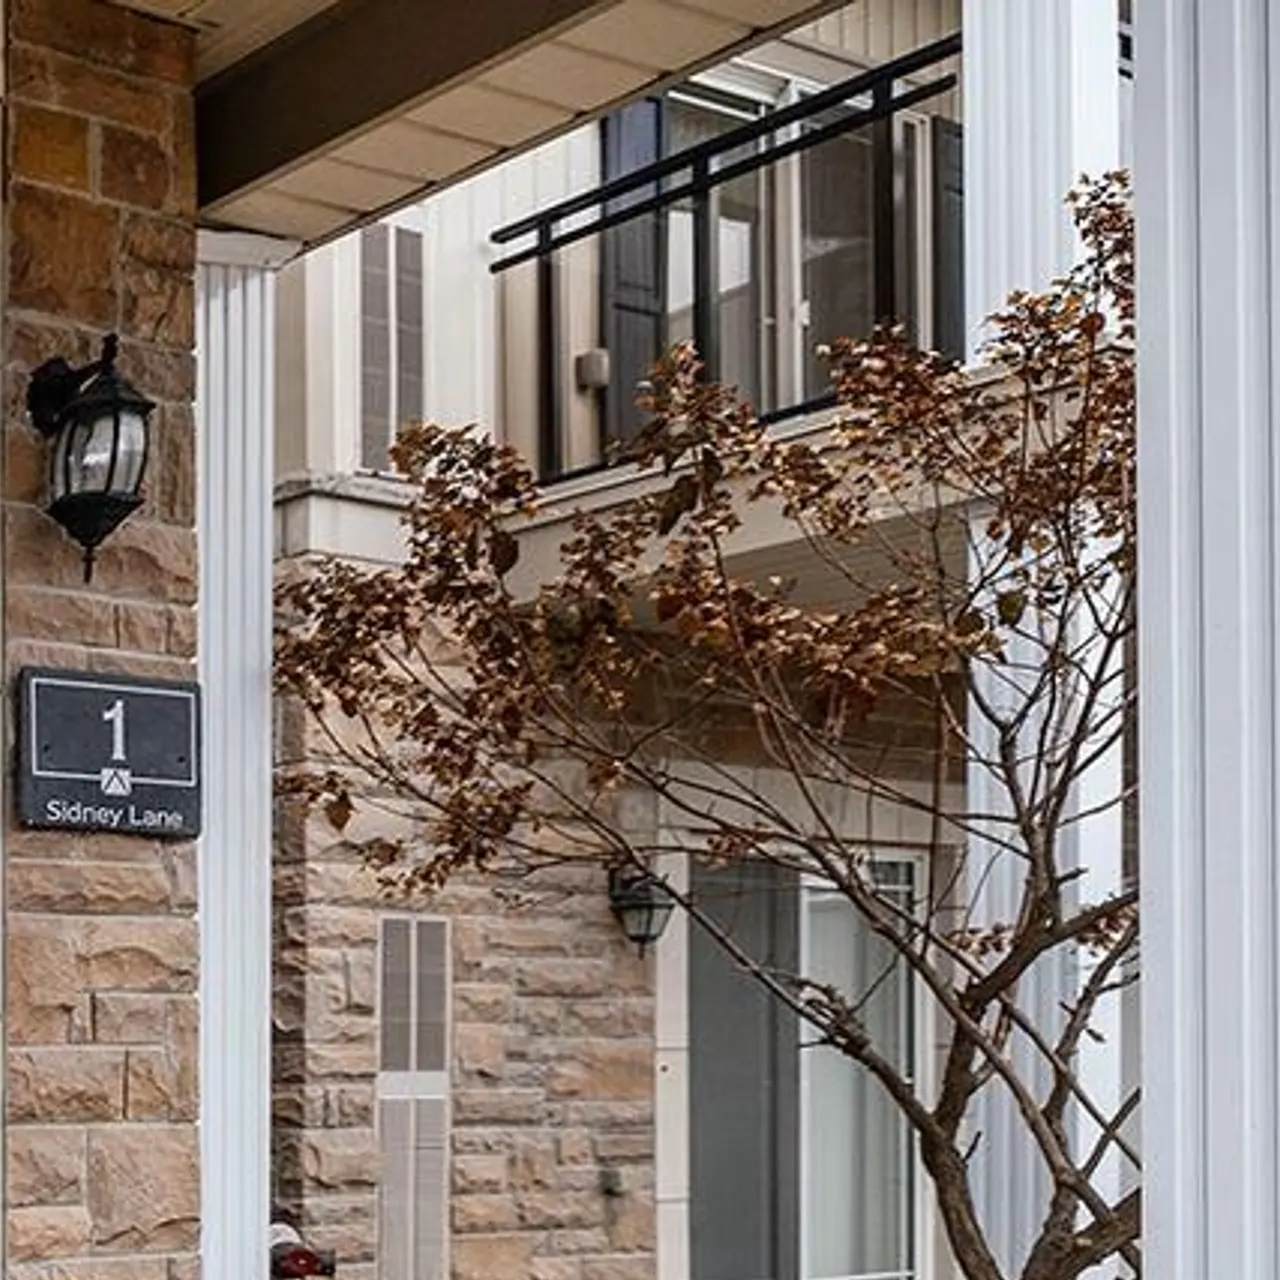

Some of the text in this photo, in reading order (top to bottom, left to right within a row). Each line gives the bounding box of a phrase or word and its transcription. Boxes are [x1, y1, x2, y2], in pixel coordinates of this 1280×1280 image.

[102, 699, 127, 761] 1
[45, 799, 184, 831] Sidney Lane
